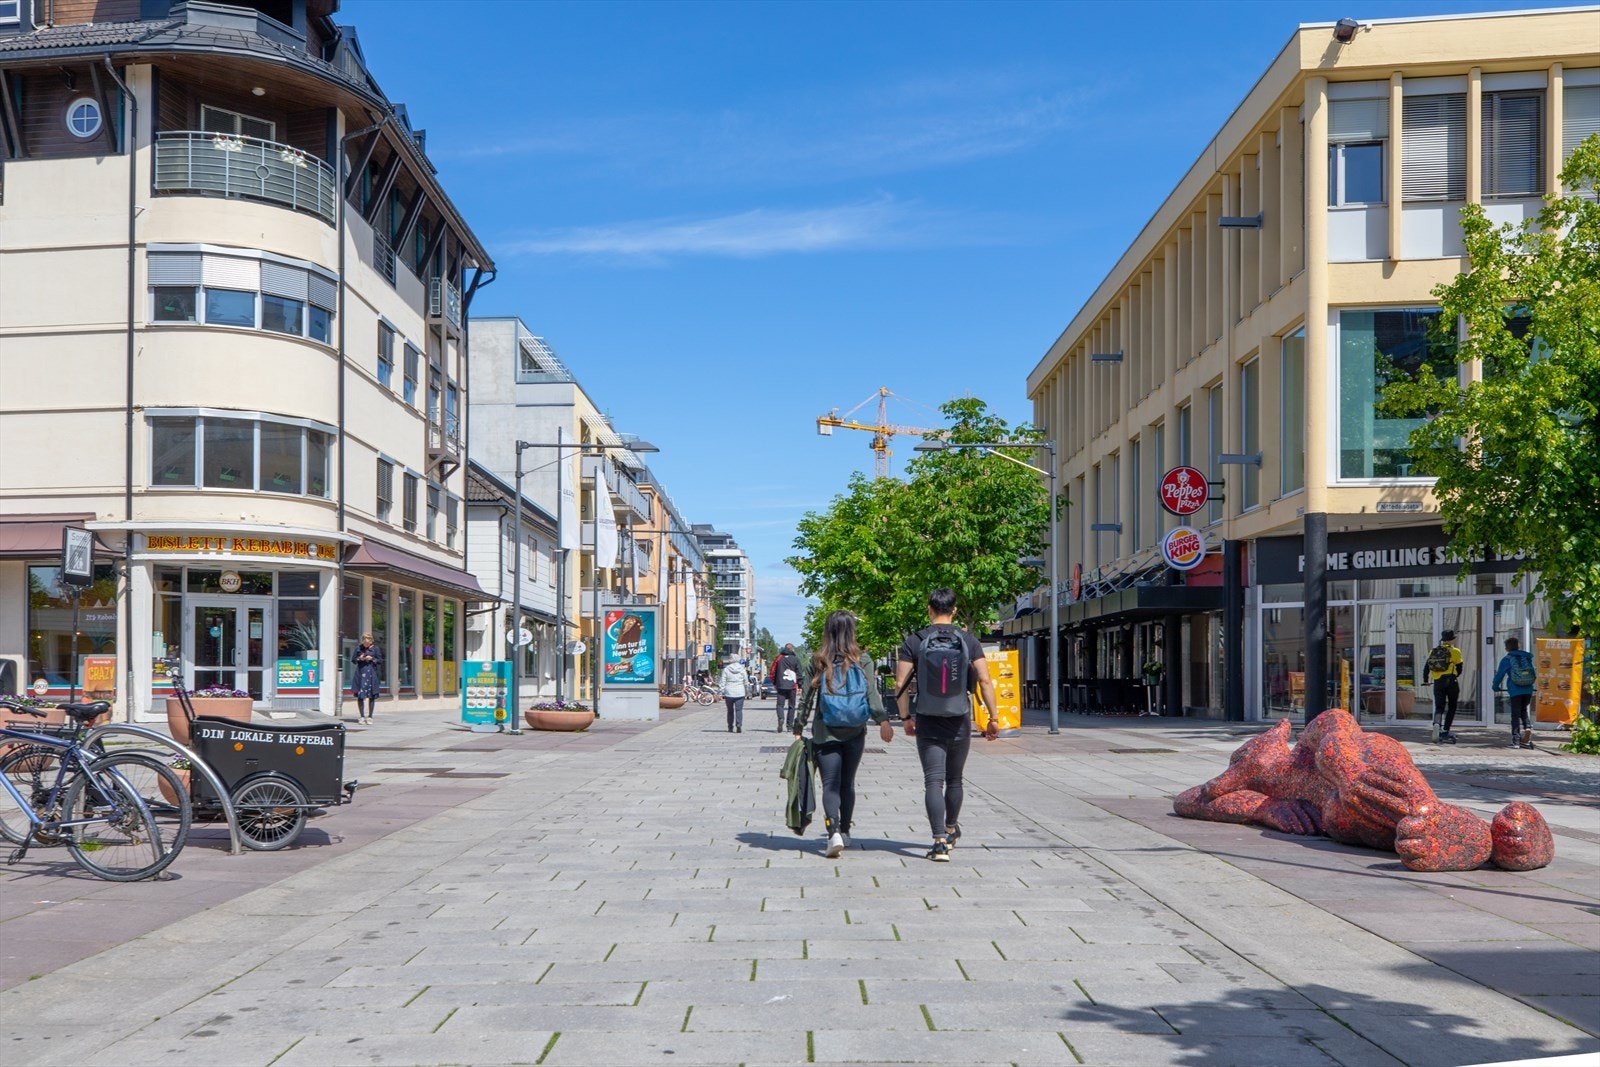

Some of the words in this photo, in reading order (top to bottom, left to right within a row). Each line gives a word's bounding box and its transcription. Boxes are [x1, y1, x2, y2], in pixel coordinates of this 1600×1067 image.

[1164, 483, 1203, 500] Peppes
[147, 535, 227, 550] BISLETT
[232, 537, 293, 554] KEBAB
[1168, 534, 1198, 550] BURGER
[1170, 541, 1200, 560] KING
[1298, 552, 1348, 573] FME
[1353, 547, 1430, 569] GRILLING
[611, 642, 627, 651] Vinn
[638, 639, 646, 647] til
[612, 650, 628, 658] New
[628, 646, 647, 655] York!
[88, 666, 115, 681] CRAZY
[202, 728, 225, 739] DIN
[230, 730, 273, 743] LOKALE
[279, 734, 334, 746] KAFFEBAR
